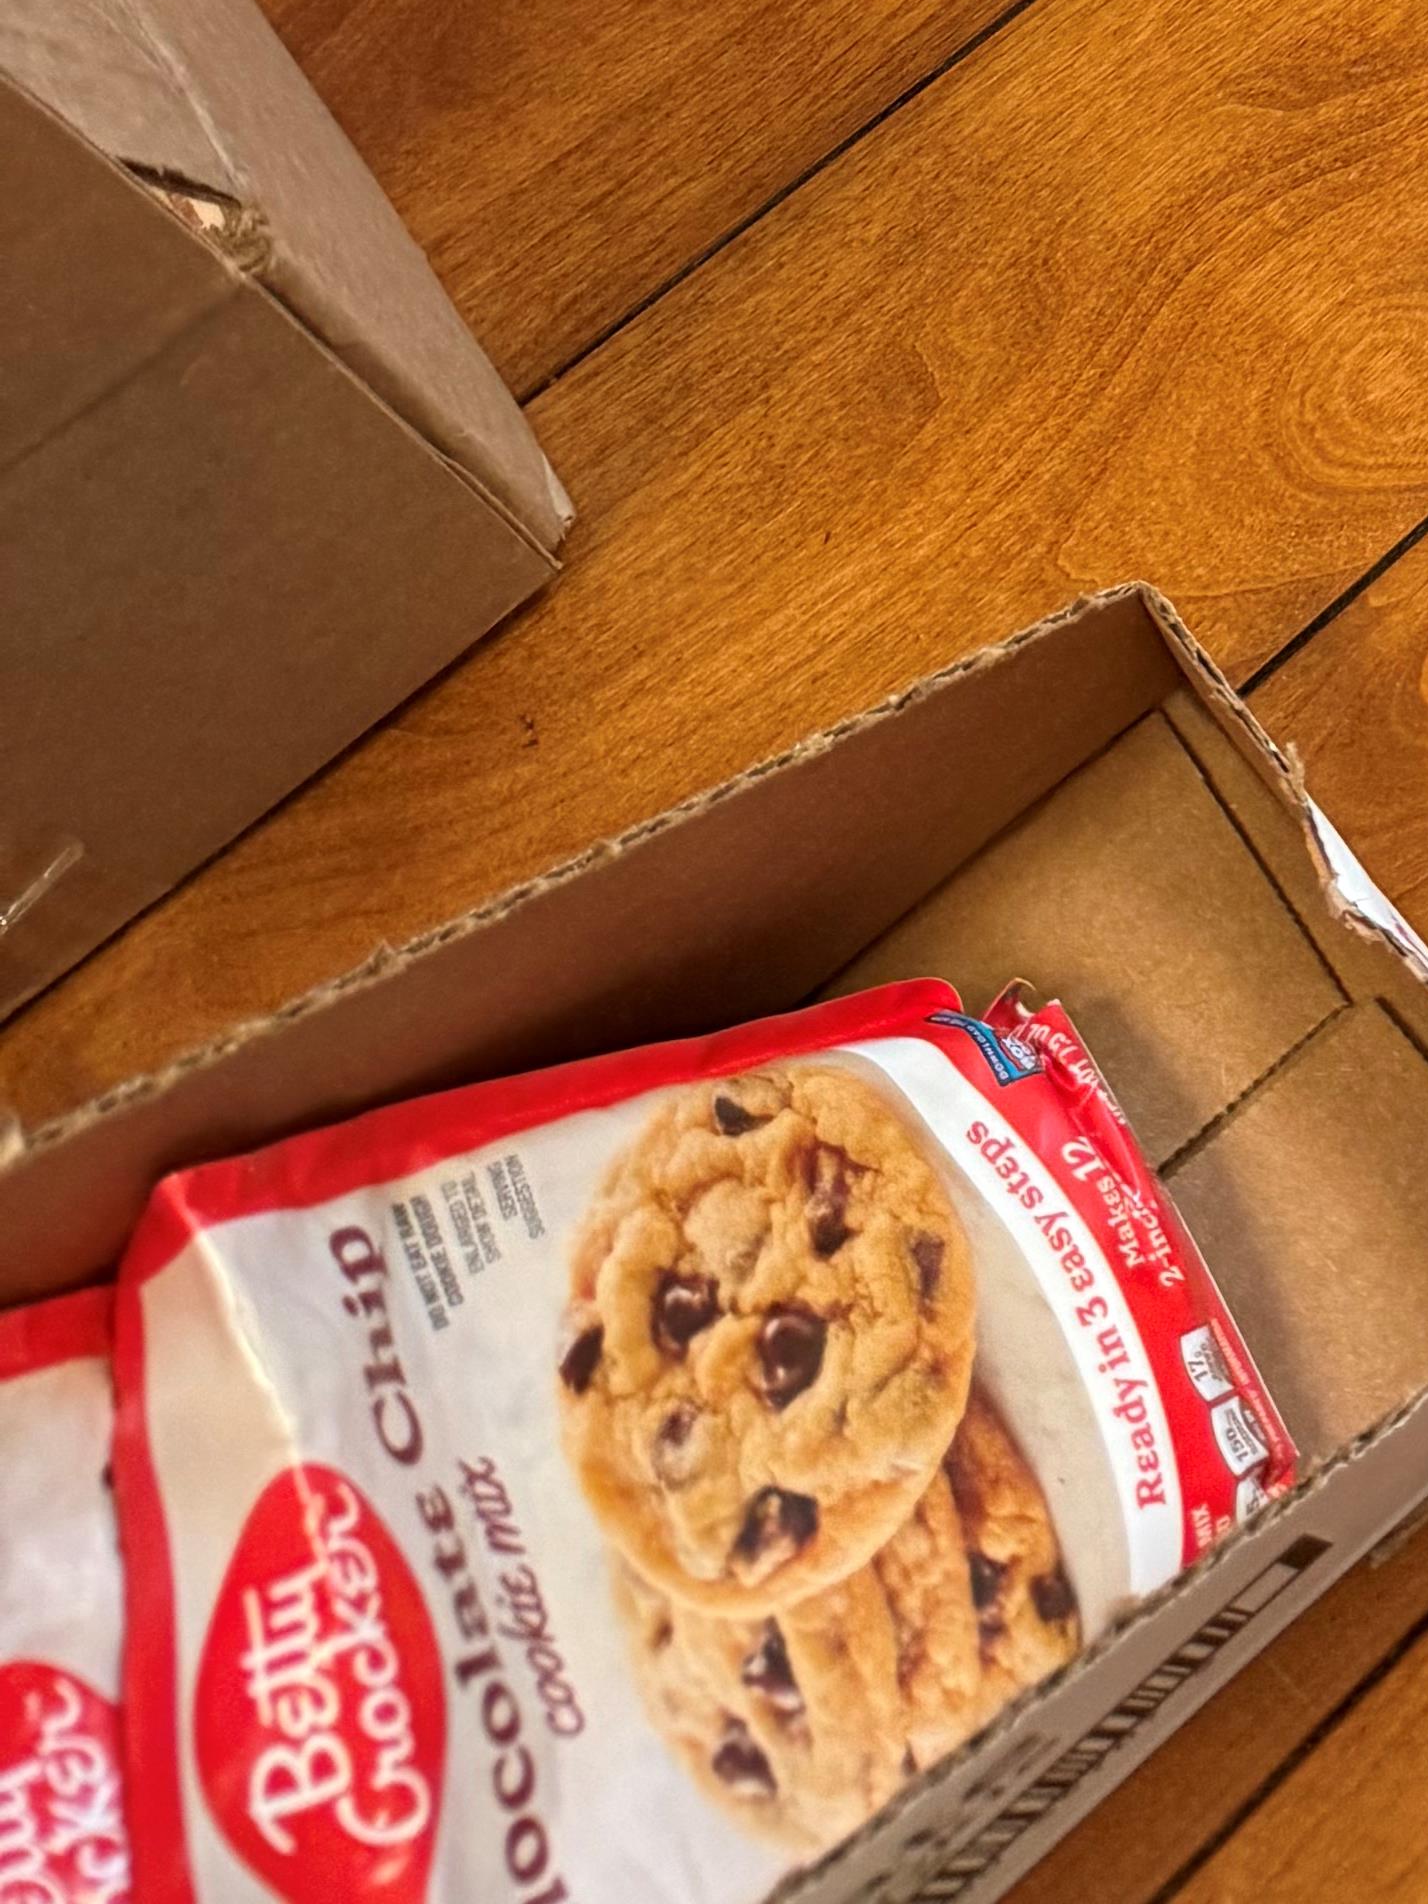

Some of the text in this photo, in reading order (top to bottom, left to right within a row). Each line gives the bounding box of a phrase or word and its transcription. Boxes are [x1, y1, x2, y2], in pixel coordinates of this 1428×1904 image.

[328, 1224, 425, 1467] Chip
[964, 1118, 1168, 1510] Ready in 3 easy steps
[1059, 1133, 1144, 1269] Makes 12
[241, 1556, 354, 1858] Betty
[313, 1483, 430, 1847] Crocker
[456, 1452, 586, 1741] cookie mix
